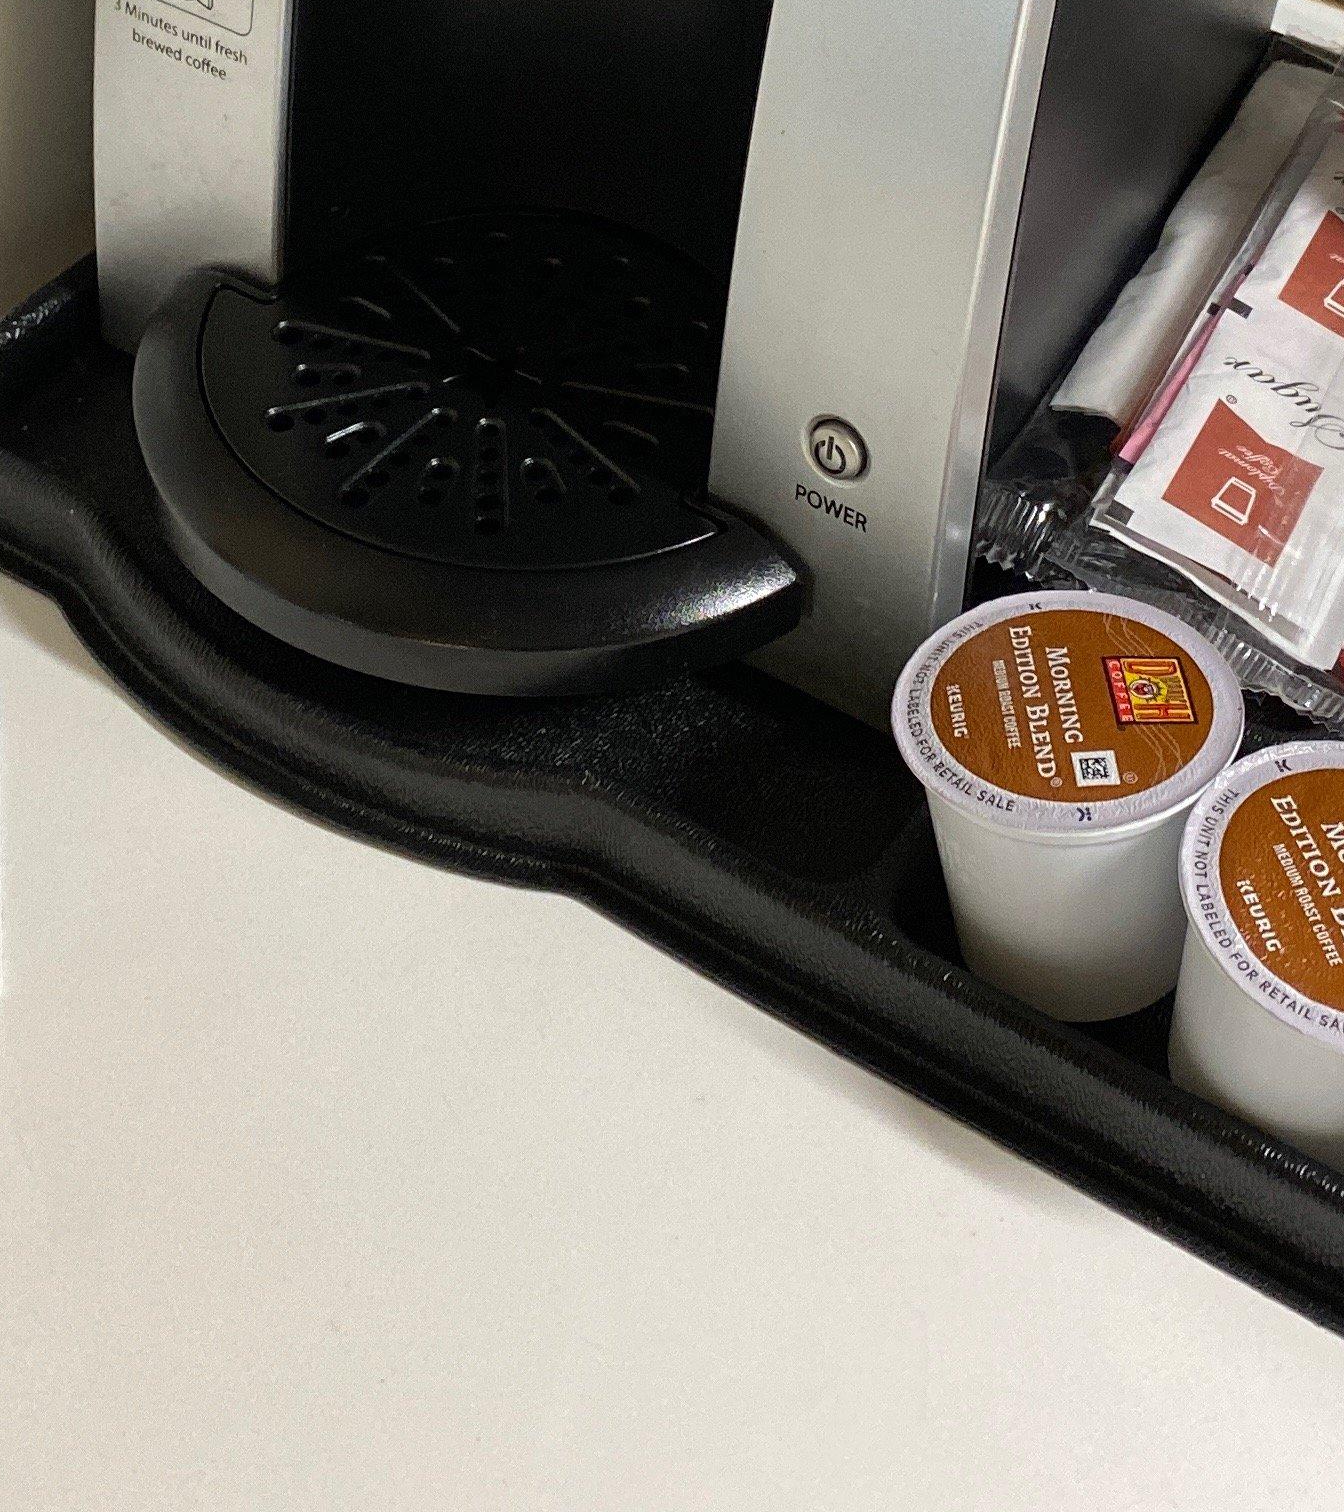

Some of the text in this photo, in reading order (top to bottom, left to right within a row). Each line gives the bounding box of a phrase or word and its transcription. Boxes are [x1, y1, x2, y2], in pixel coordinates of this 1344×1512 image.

[125, 1, 178, 37] Minutes
[181, 29, 212, 50] until
[215, 40, 248, 66] fresh
[132, 28, 227, 81] brewed coffee
[795, 483, 867, 533] POWER
[1009, 625, 1041, 698] EDITION
[946, 684, 967, 738] KEURIG
[1044, 646, 1083, 745] MORNING
[906, 689, 923, 737] LABELED
[917, 739, 936, 762] FOR
[932, 759, 972, 795] RETAIL
[977, 790, 1016, 812] SALE
[1197, 816, 1218, 848] UNIT
[1215, 789, 1239, 816] THIS
[1194, 849, 1207, 880] NOT
[1270, 794, 1341, 897] EDITION
[1196, 882, 1233, 949] LABELED
[1237, 878, 1282, 952] KEURIG
[1273, 843, 1343, 967] MEDIUM ROAST COFFEE
[1231, 952, 1259, 981] FOR
[1259, 981, 1312, 1020] RETAIL
